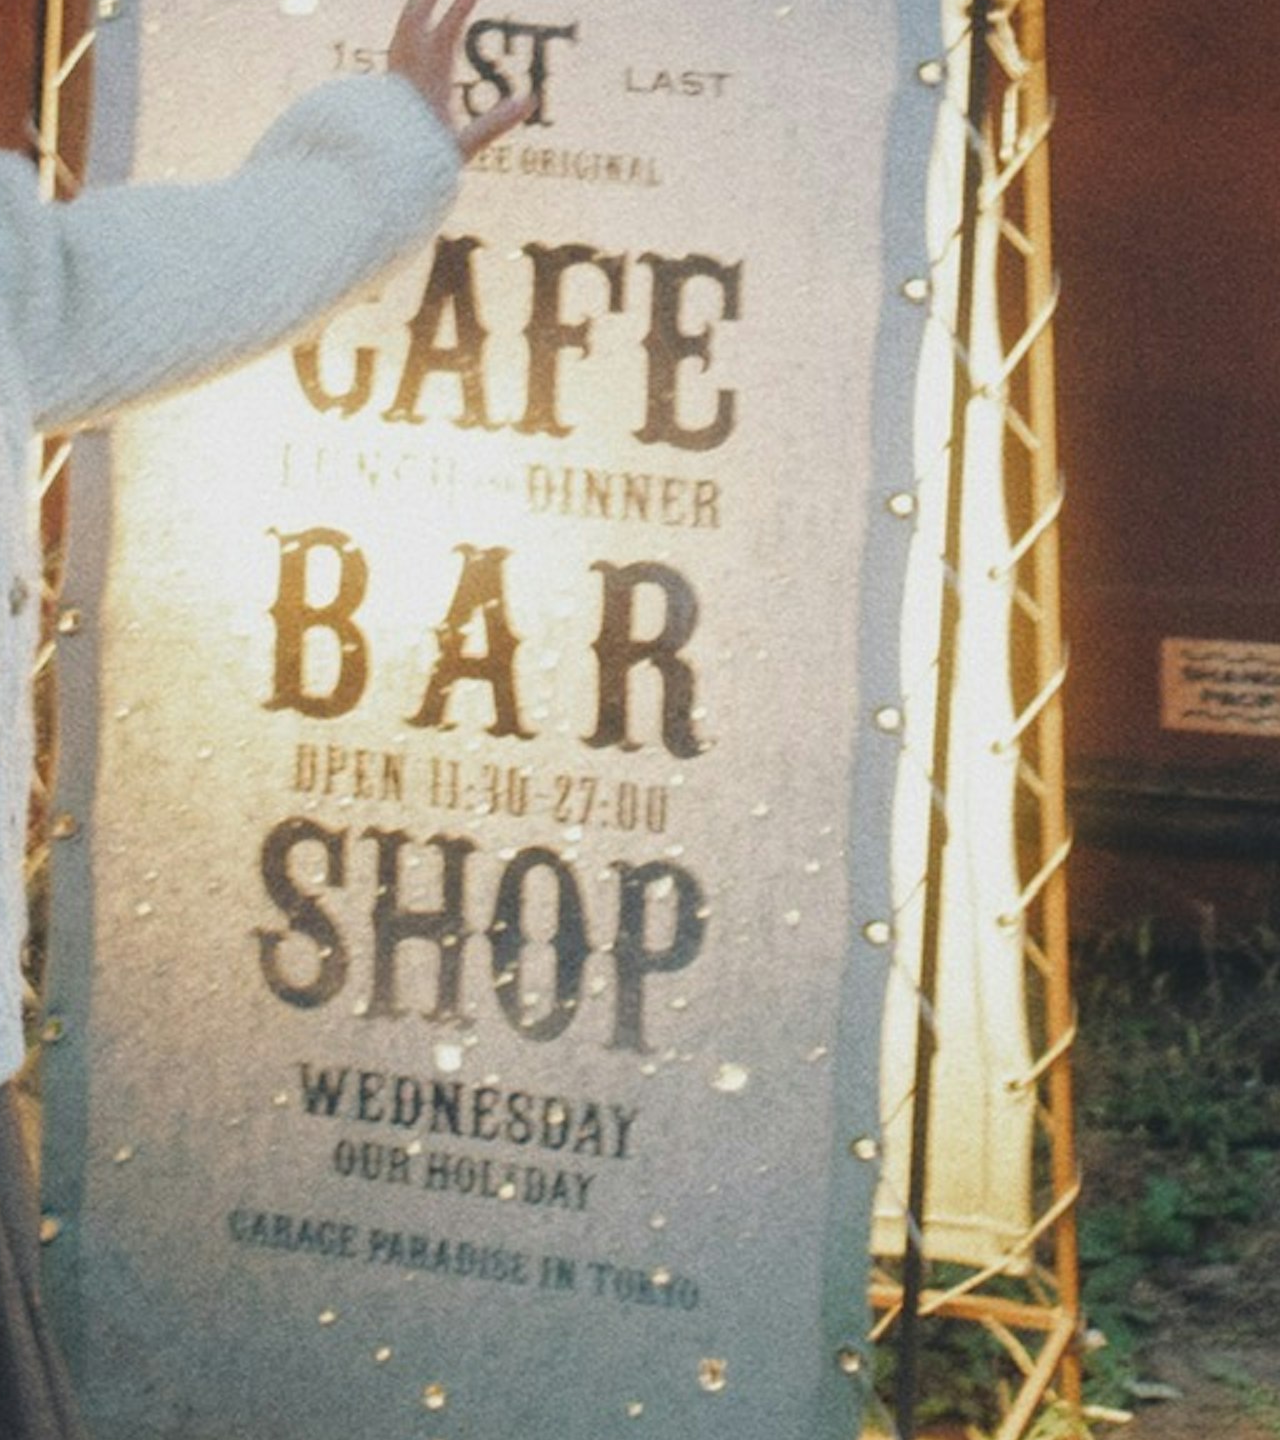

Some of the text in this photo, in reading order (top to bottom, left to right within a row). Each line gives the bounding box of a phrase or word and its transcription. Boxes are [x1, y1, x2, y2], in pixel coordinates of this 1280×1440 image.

[623, 66, 733, 99] LAST
[525, 461, 723, 530] DINNER
[262, 526, 717, 760] BAR
[292, 742, 406, 803] OPEN
[253, 814, 711, 1056] SHOP
[297, 1062, 641, 1160] WEDNESDAY
[333, 1138, 411, 1186] OUR
[227, 1208, 359, 1260] GARAGE
